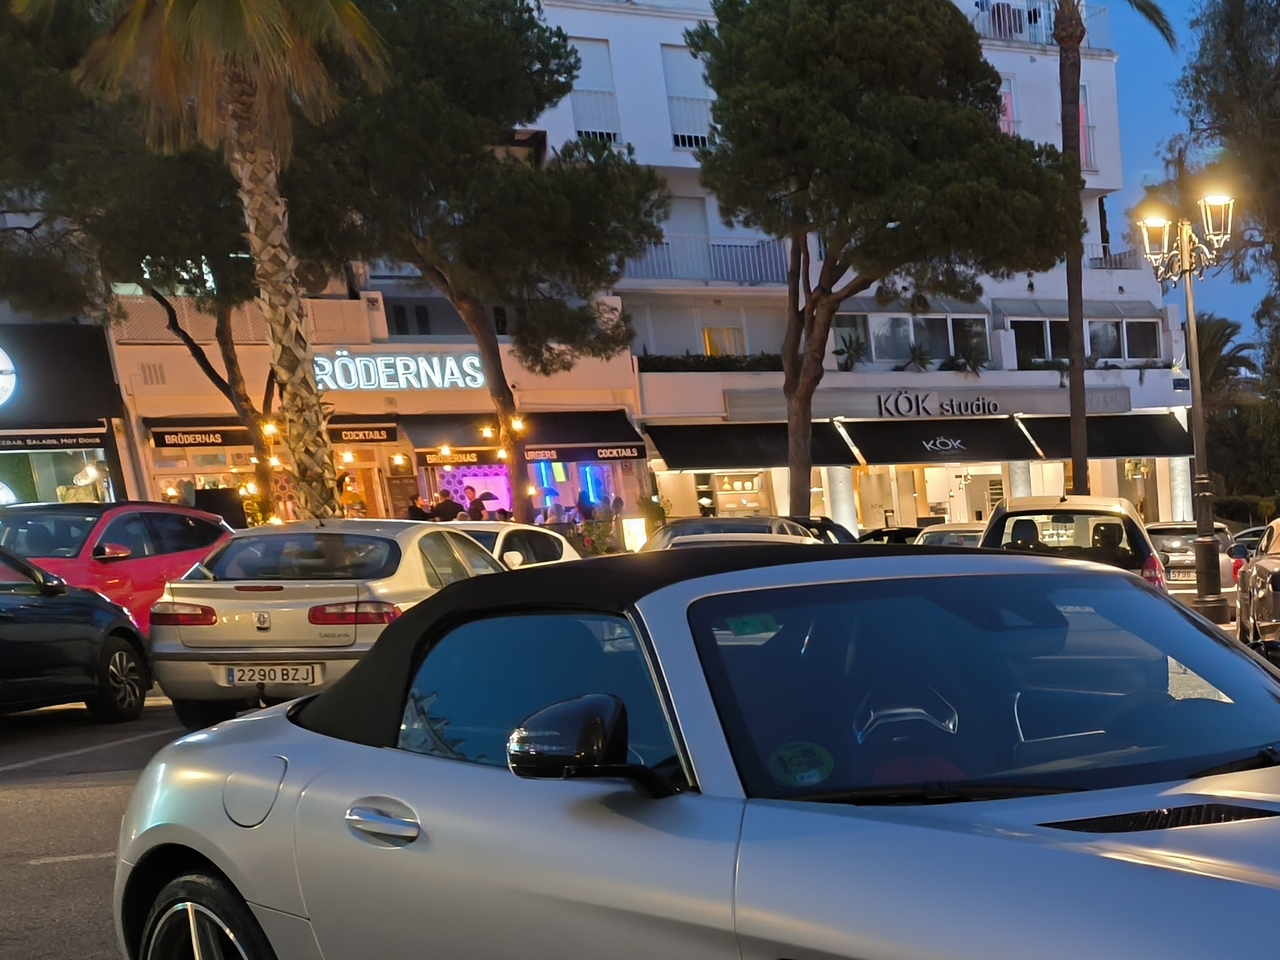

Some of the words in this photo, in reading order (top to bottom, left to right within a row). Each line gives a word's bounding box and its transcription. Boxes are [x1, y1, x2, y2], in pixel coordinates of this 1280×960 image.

[313, 350, 485, 390] RÖDERNAS
[876, 390, 933, 417] KÖK
[939, 396, 999, 416] studio
[165, 432, 222, 444] BRÖDERNAS
[341, 430, 387, 440] COCKTAILS
[921, 436, 967, 452] KÖK
[524, 450, 557, 460] URGERS
[597, 448, 638, 458] COCKTAILS
[237, 668, 277, 682] 2290
[281, 667, 310, 681] BZJ
